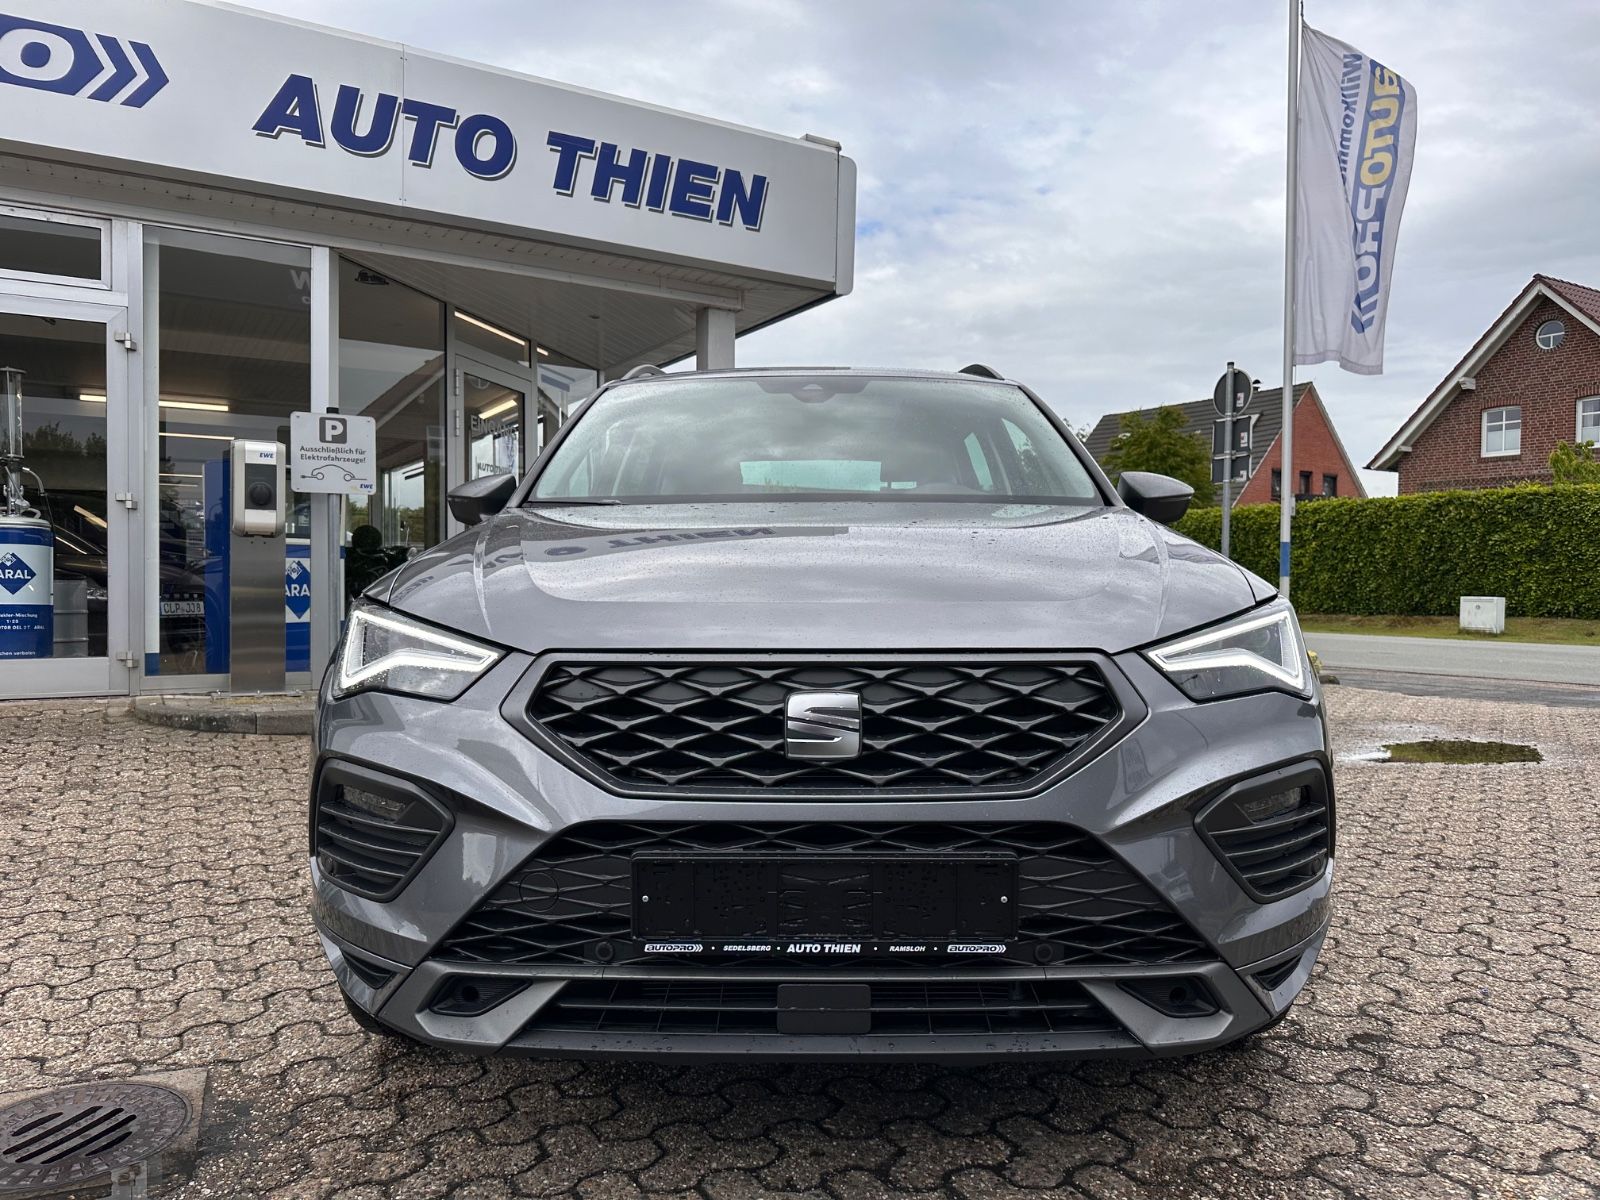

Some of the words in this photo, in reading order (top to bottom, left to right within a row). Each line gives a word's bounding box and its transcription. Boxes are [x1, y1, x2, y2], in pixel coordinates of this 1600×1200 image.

[252, 73, 517, 181] AUTO
[546, 130, 769, 232] THIEN
[325, 419, 344, 442] P
[300, 445, 354, 455] Ausschließlich
[355, 447, 367, 456] für
[300, 454, 366, 464] Elektrofahrzeuge!
[786, 944, 821, 953] AUTO
[823, 944, 862, 953] THIEN
